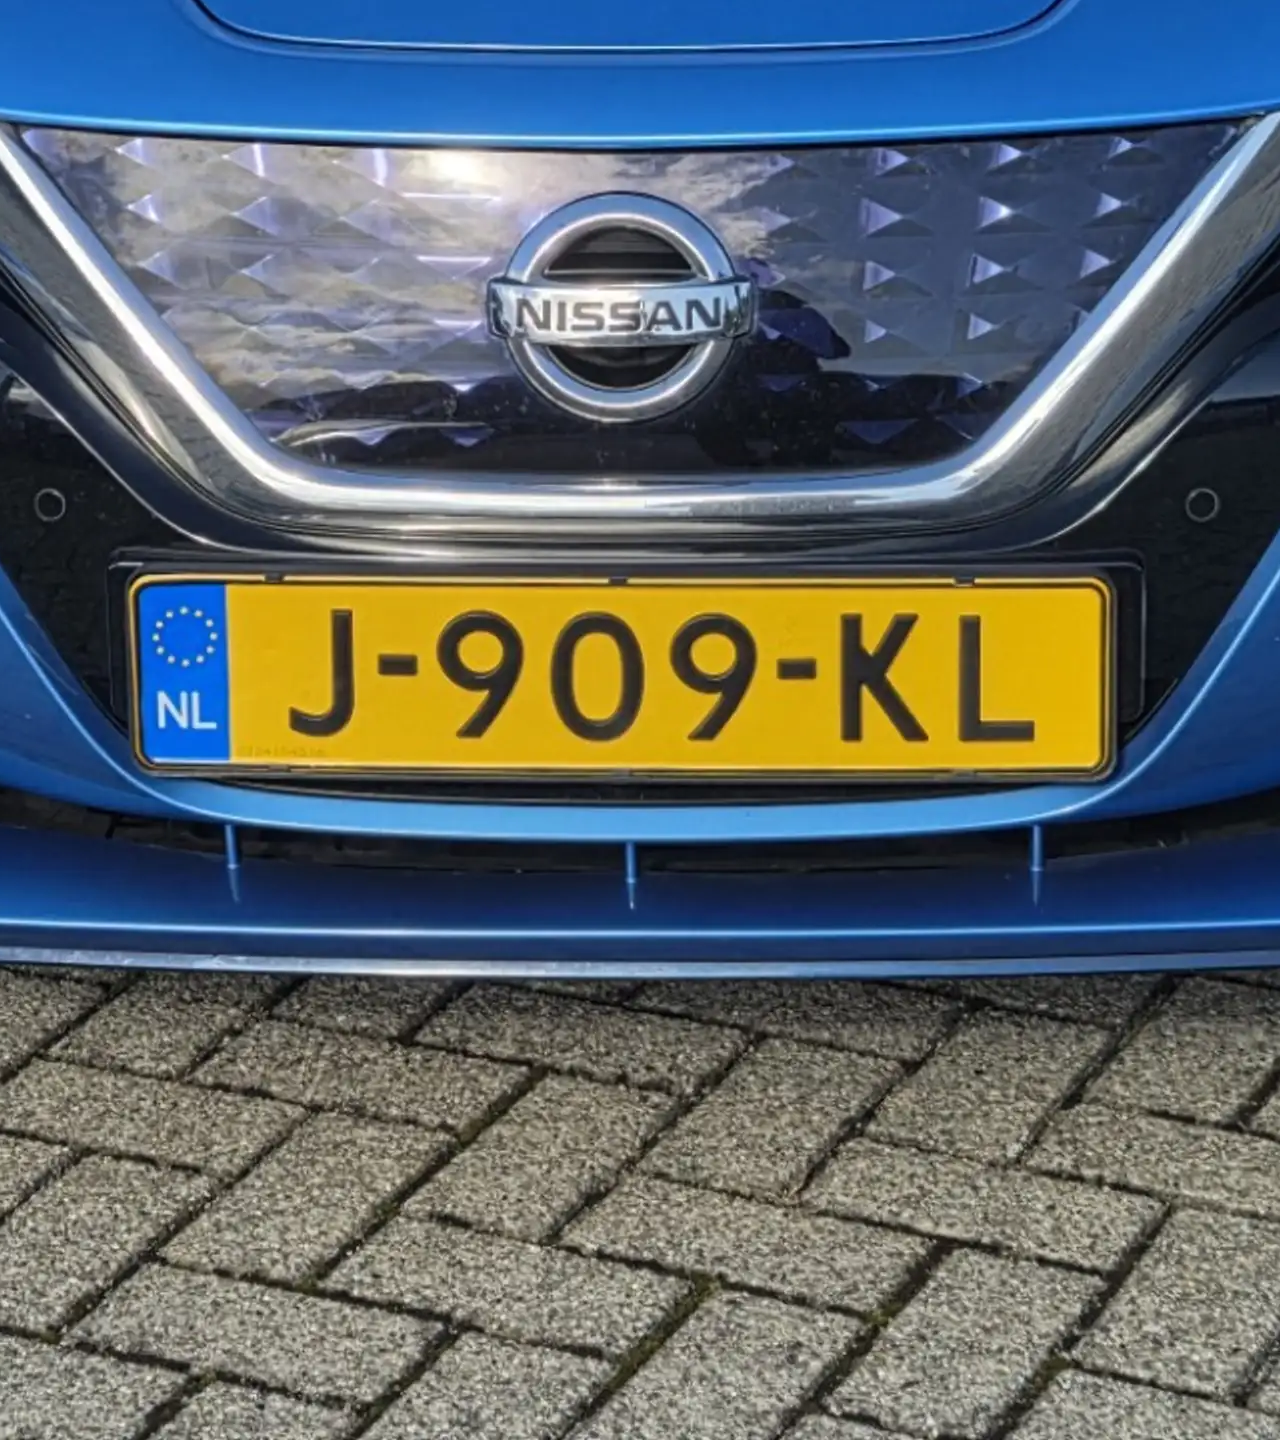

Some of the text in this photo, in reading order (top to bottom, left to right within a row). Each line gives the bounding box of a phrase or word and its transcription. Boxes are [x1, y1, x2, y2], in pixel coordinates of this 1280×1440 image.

[516, 296, 721, 333] NISSAN
[288, 608, 1036, 742] J-909-KL
[156, 690, 218, 730] NL
